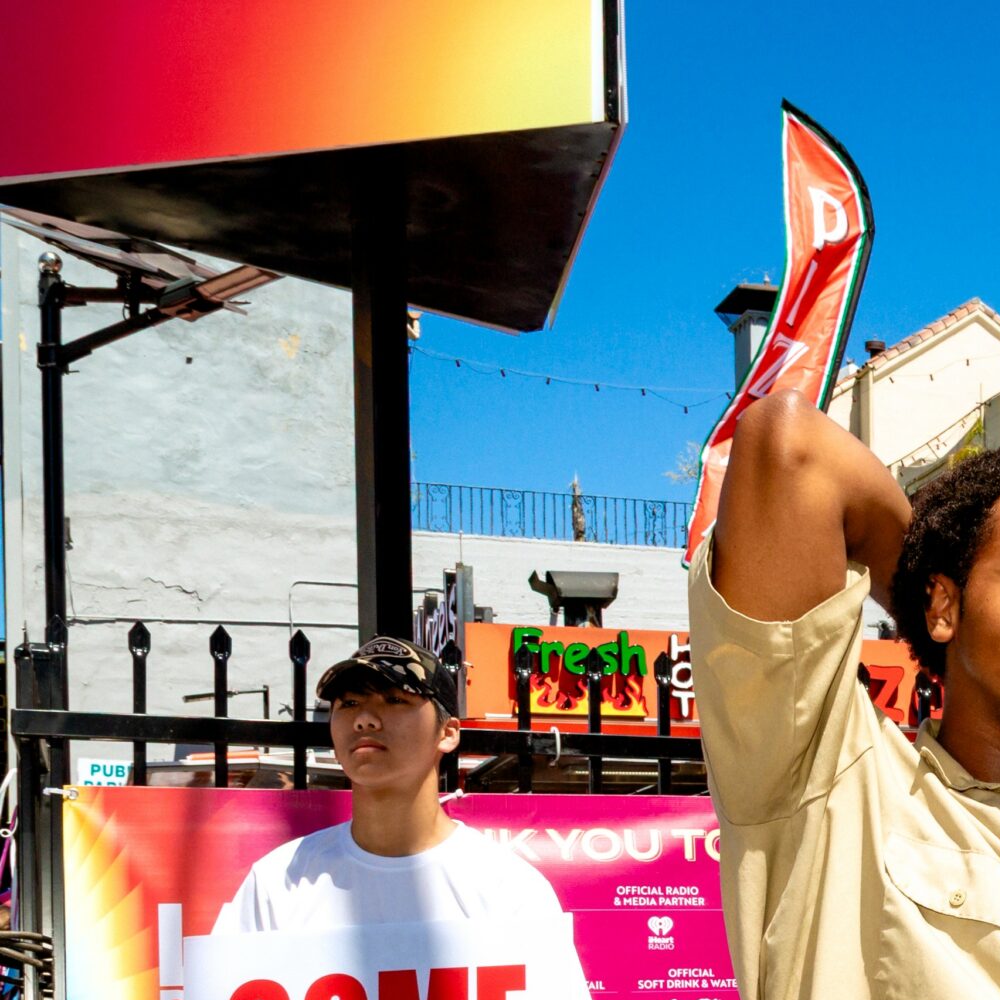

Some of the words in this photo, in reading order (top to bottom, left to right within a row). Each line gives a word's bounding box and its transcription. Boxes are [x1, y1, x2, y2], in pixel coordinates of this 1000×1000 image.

[512, 627, 647, 676] Fresh
[90, 763, 134, 778] PUB
[545, 828, 662, 862] YOU
[616, 885, 664, 896] OFFICIAL
[666, 885, 699, 896] RADIO
[613, 897, 621, 906] &
[623, 897, 657, 906] MEDIA
[659, 896, 705, 907] PARTNER
[668, 968, 714, 978] OFFICIAL
[638, 980, 664, 989] SOFT
[667, 979, 699, 989] DRINK
[701, 979, 709, 988] &
[710, 978, 738, 988] WATE
